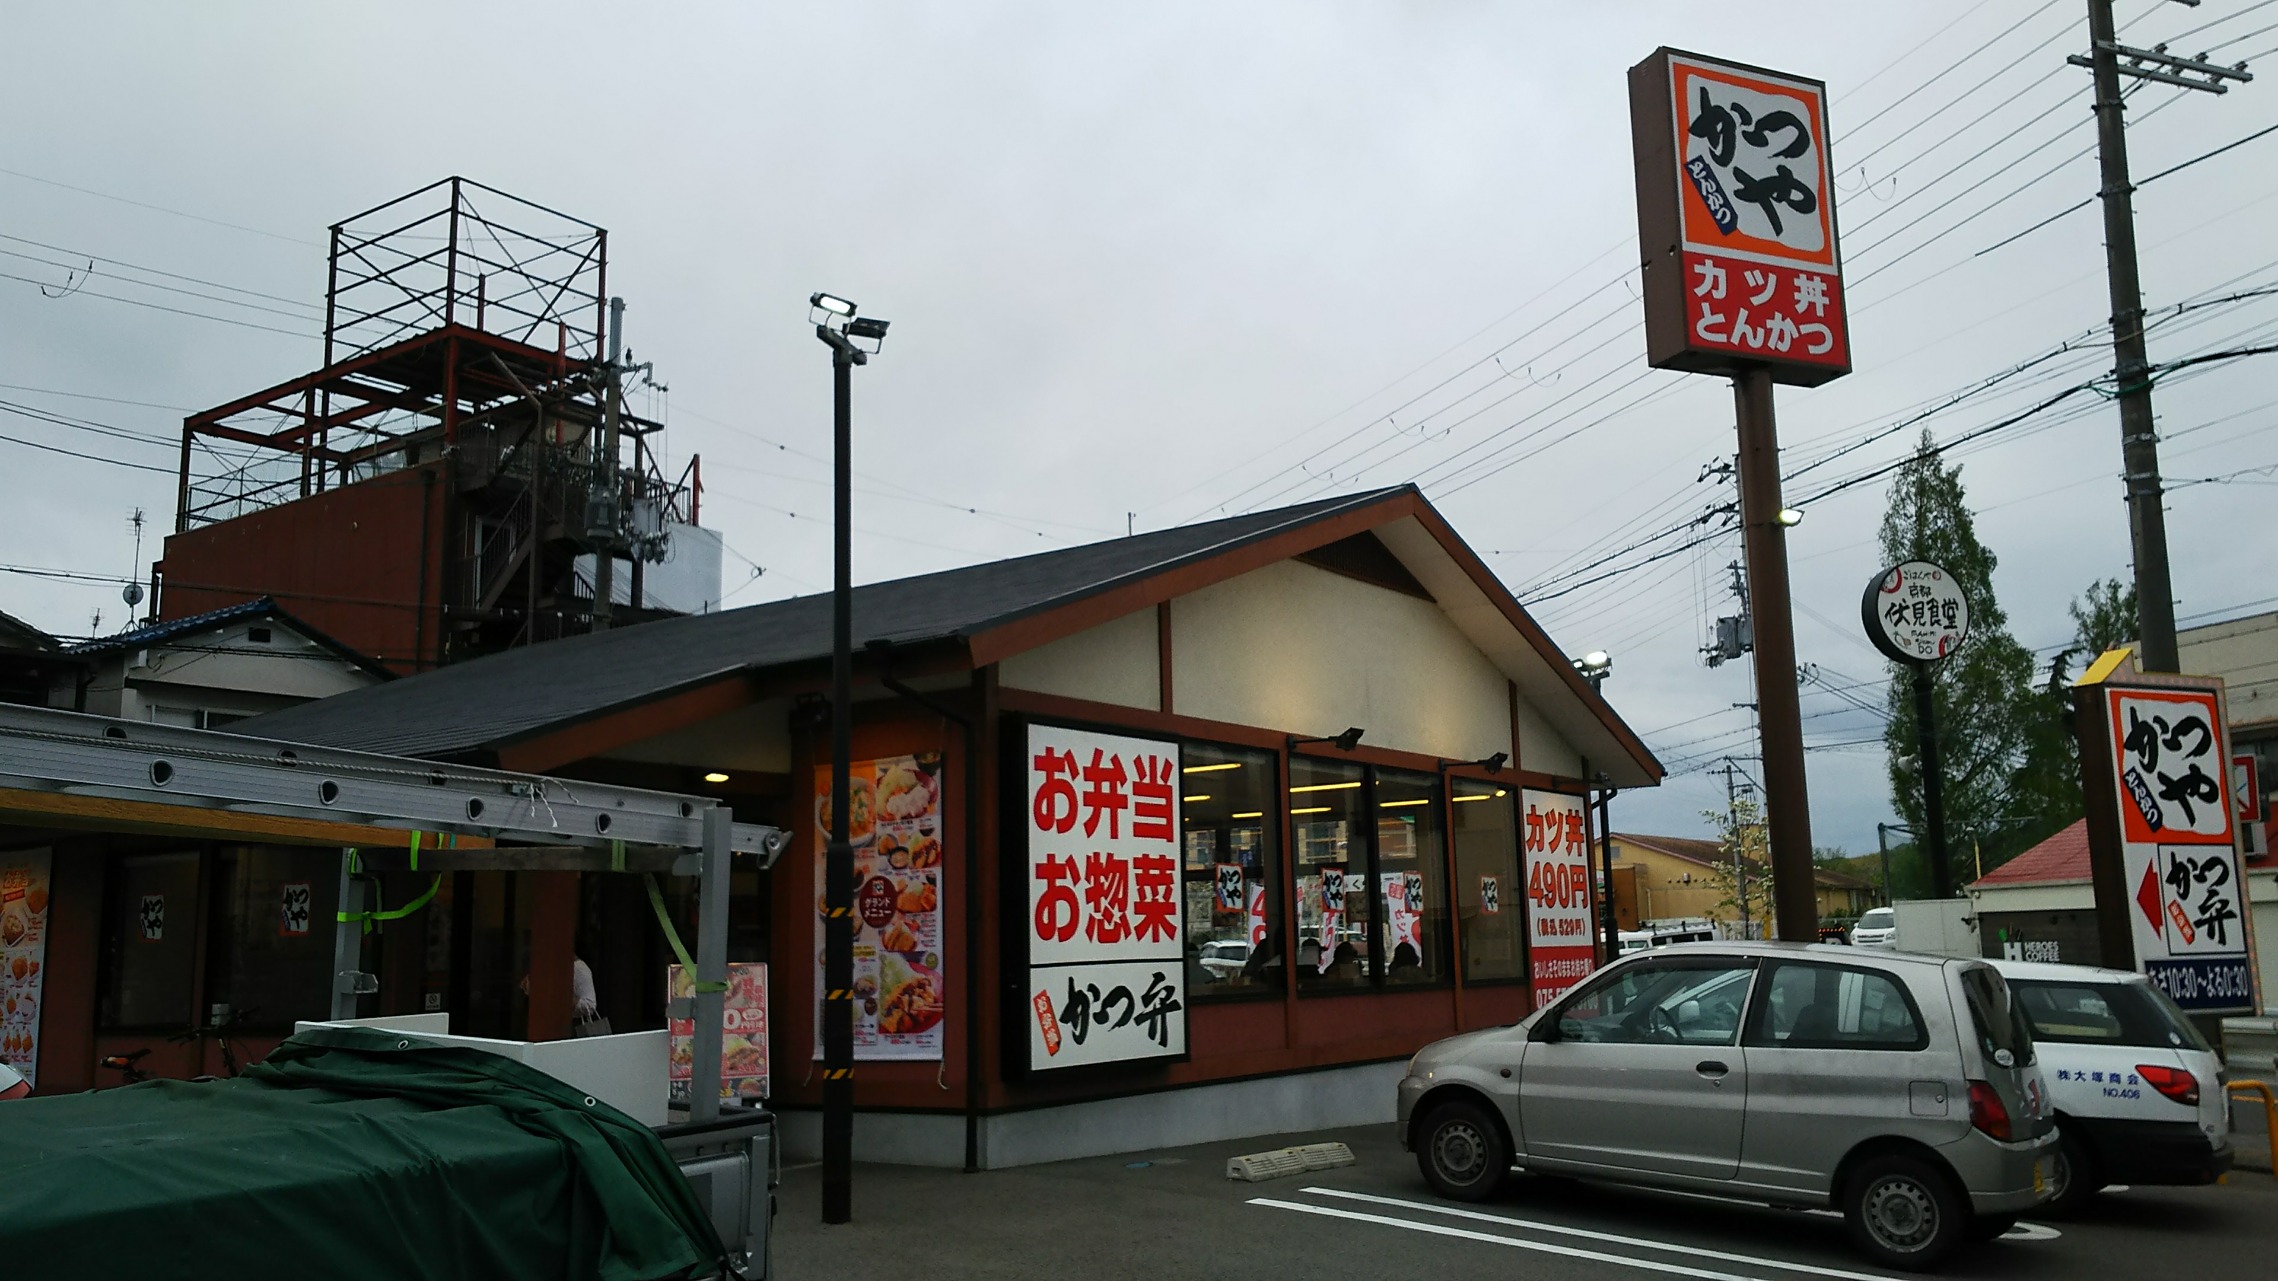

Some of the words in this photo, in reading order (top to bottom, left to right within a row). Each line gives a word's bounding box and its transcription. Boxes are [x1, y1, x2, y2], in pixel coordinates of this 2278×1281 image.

[1694, 260, 1829, 317] カツ丼
[1697, 303, 1833, 354] とんかつ
[1885, 598, 1959, 630] 伏見食堂
[1032, 746, 1174, 842] お弁当
[1526, 804, 1584, 857] カツ丼
[1035, 852, 1177, 943] お惣菜
[1529, 861, 1588, 909] 490円
